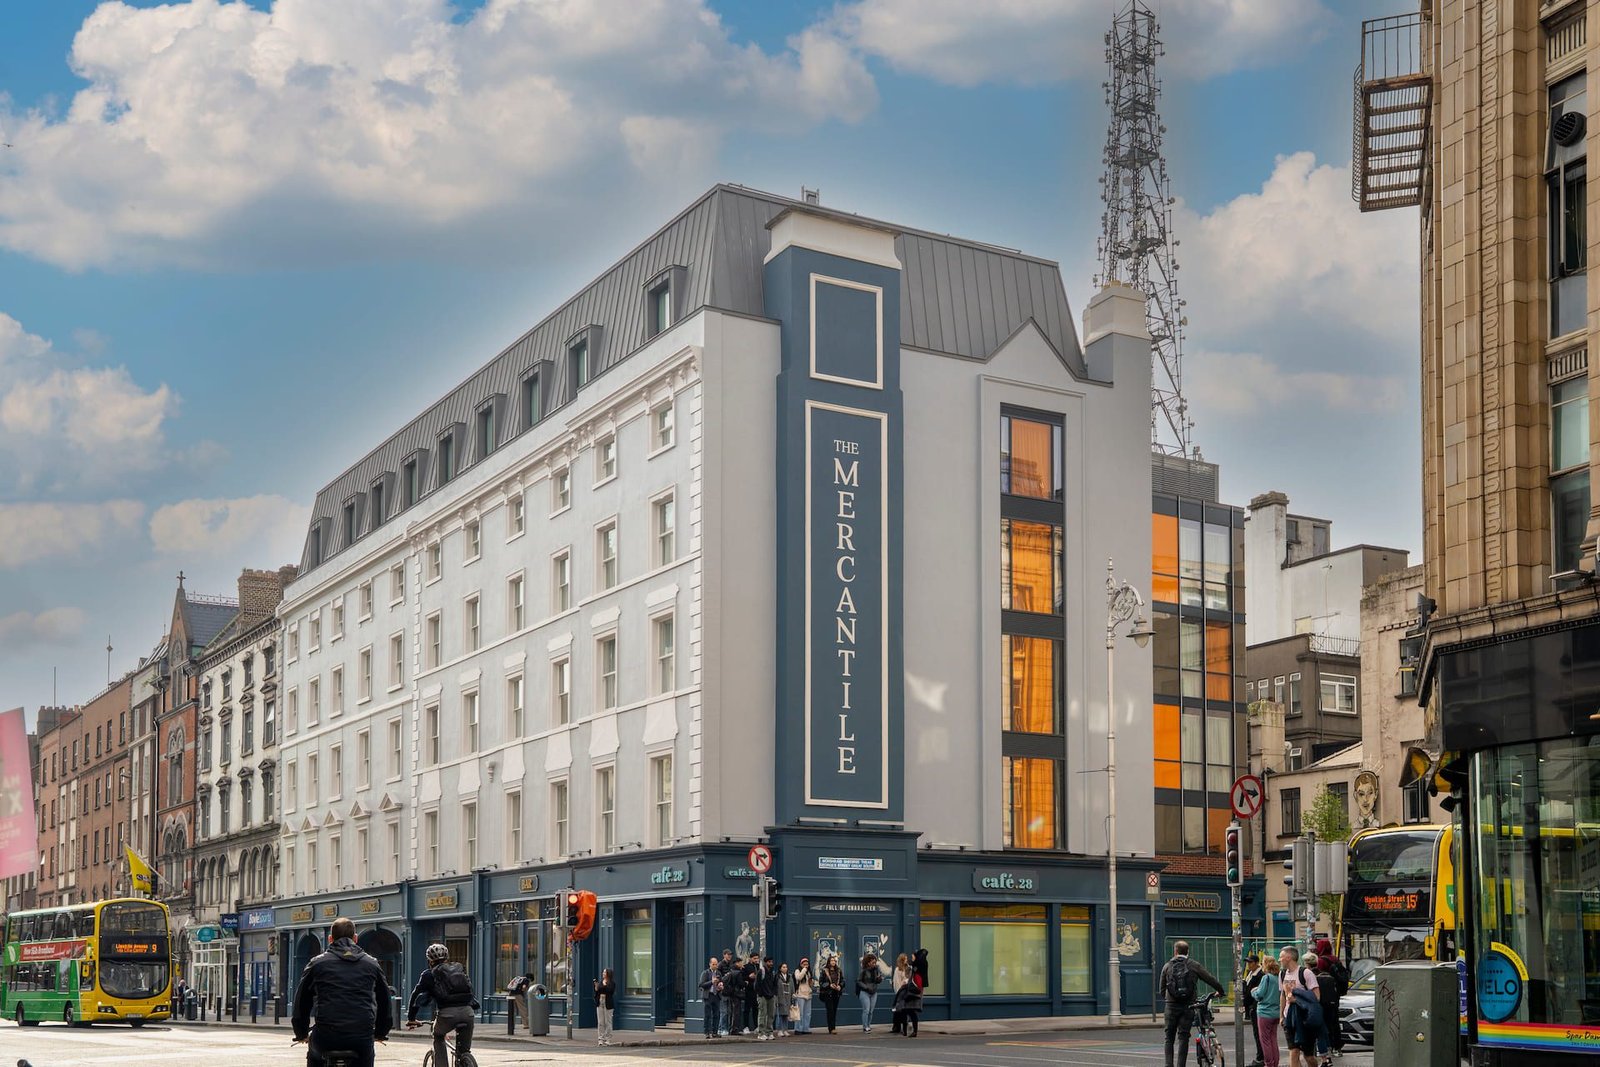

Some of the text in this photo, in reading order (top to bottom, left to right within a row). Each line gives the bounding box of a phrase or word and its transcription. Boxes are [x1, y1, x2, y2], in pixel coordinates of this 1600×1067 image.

[833, 439, 860, 455] THE
[833, 457, 860, 775] MERCANTILE
[651, 866, 684, 884] café.28
[981, 872, 1033, 890] café.28
[1166, 898, 1216, 908] MERCANTILE
[1387, 895, 1406, 903] Street
[847, 904, 876, 912] CHARACTER
[151, 943, 157, 953] 9
